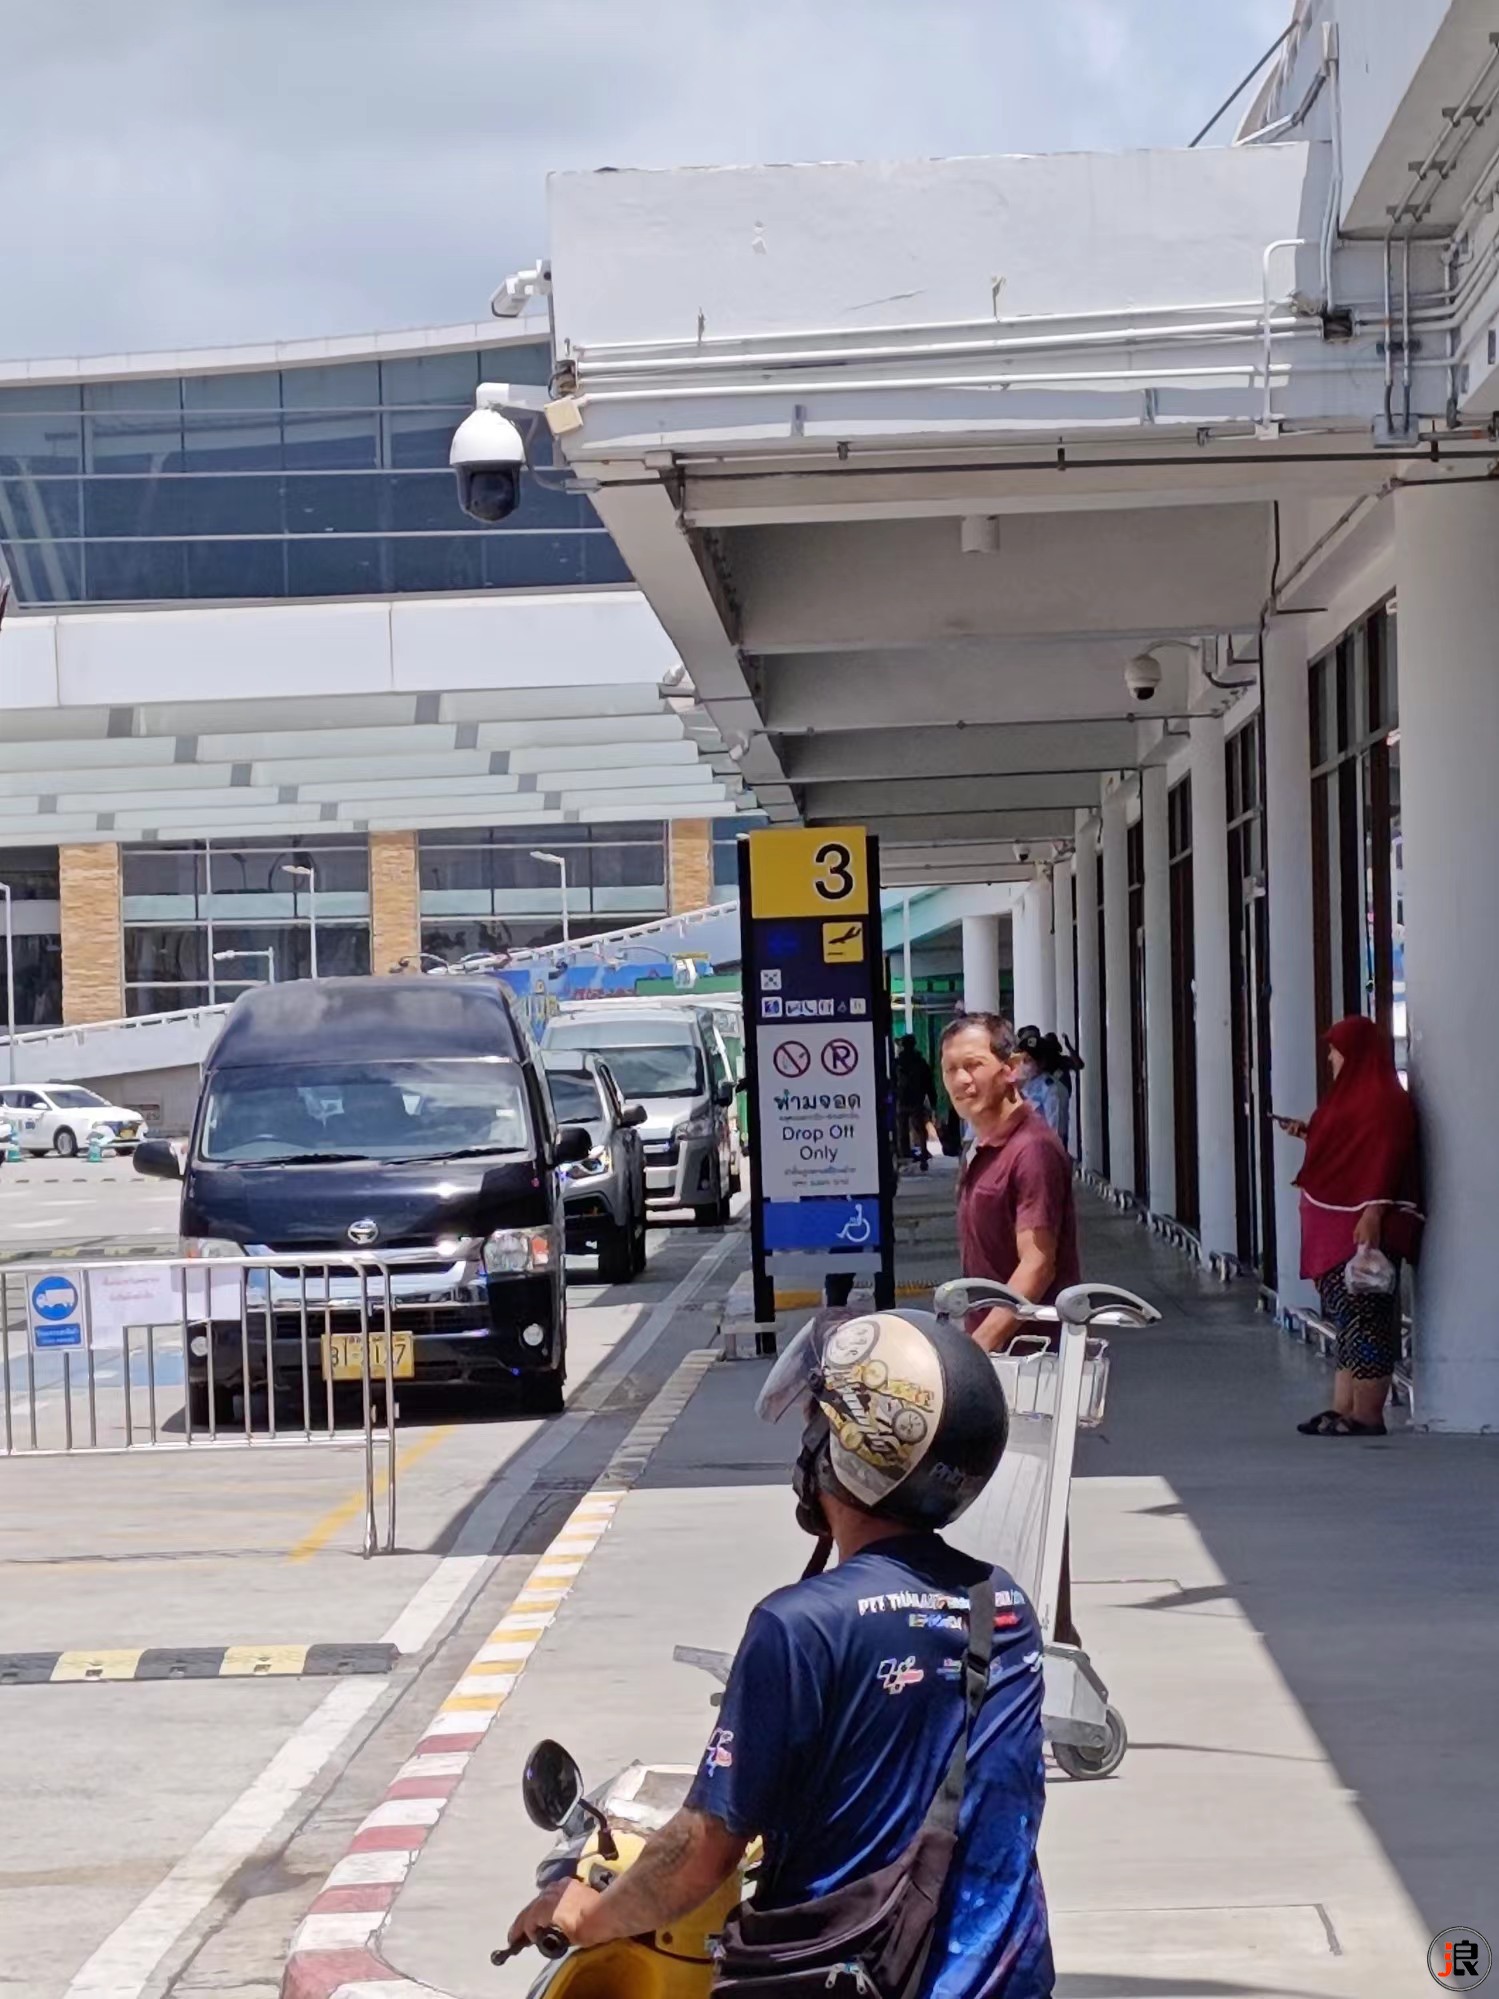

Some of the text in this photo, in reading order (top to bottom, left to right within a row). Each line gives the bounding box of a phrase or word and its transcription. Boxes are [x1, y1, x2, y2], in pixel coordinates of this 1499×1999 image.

[815, 843, 854, 900] 3
[773, 1088, 861, 1111] ห้ามจอด
[782, 1126, 824, 1144] Drop
[800, 1145, 838, 1163] Only
[858, 1595, 885, 1616] PTT
